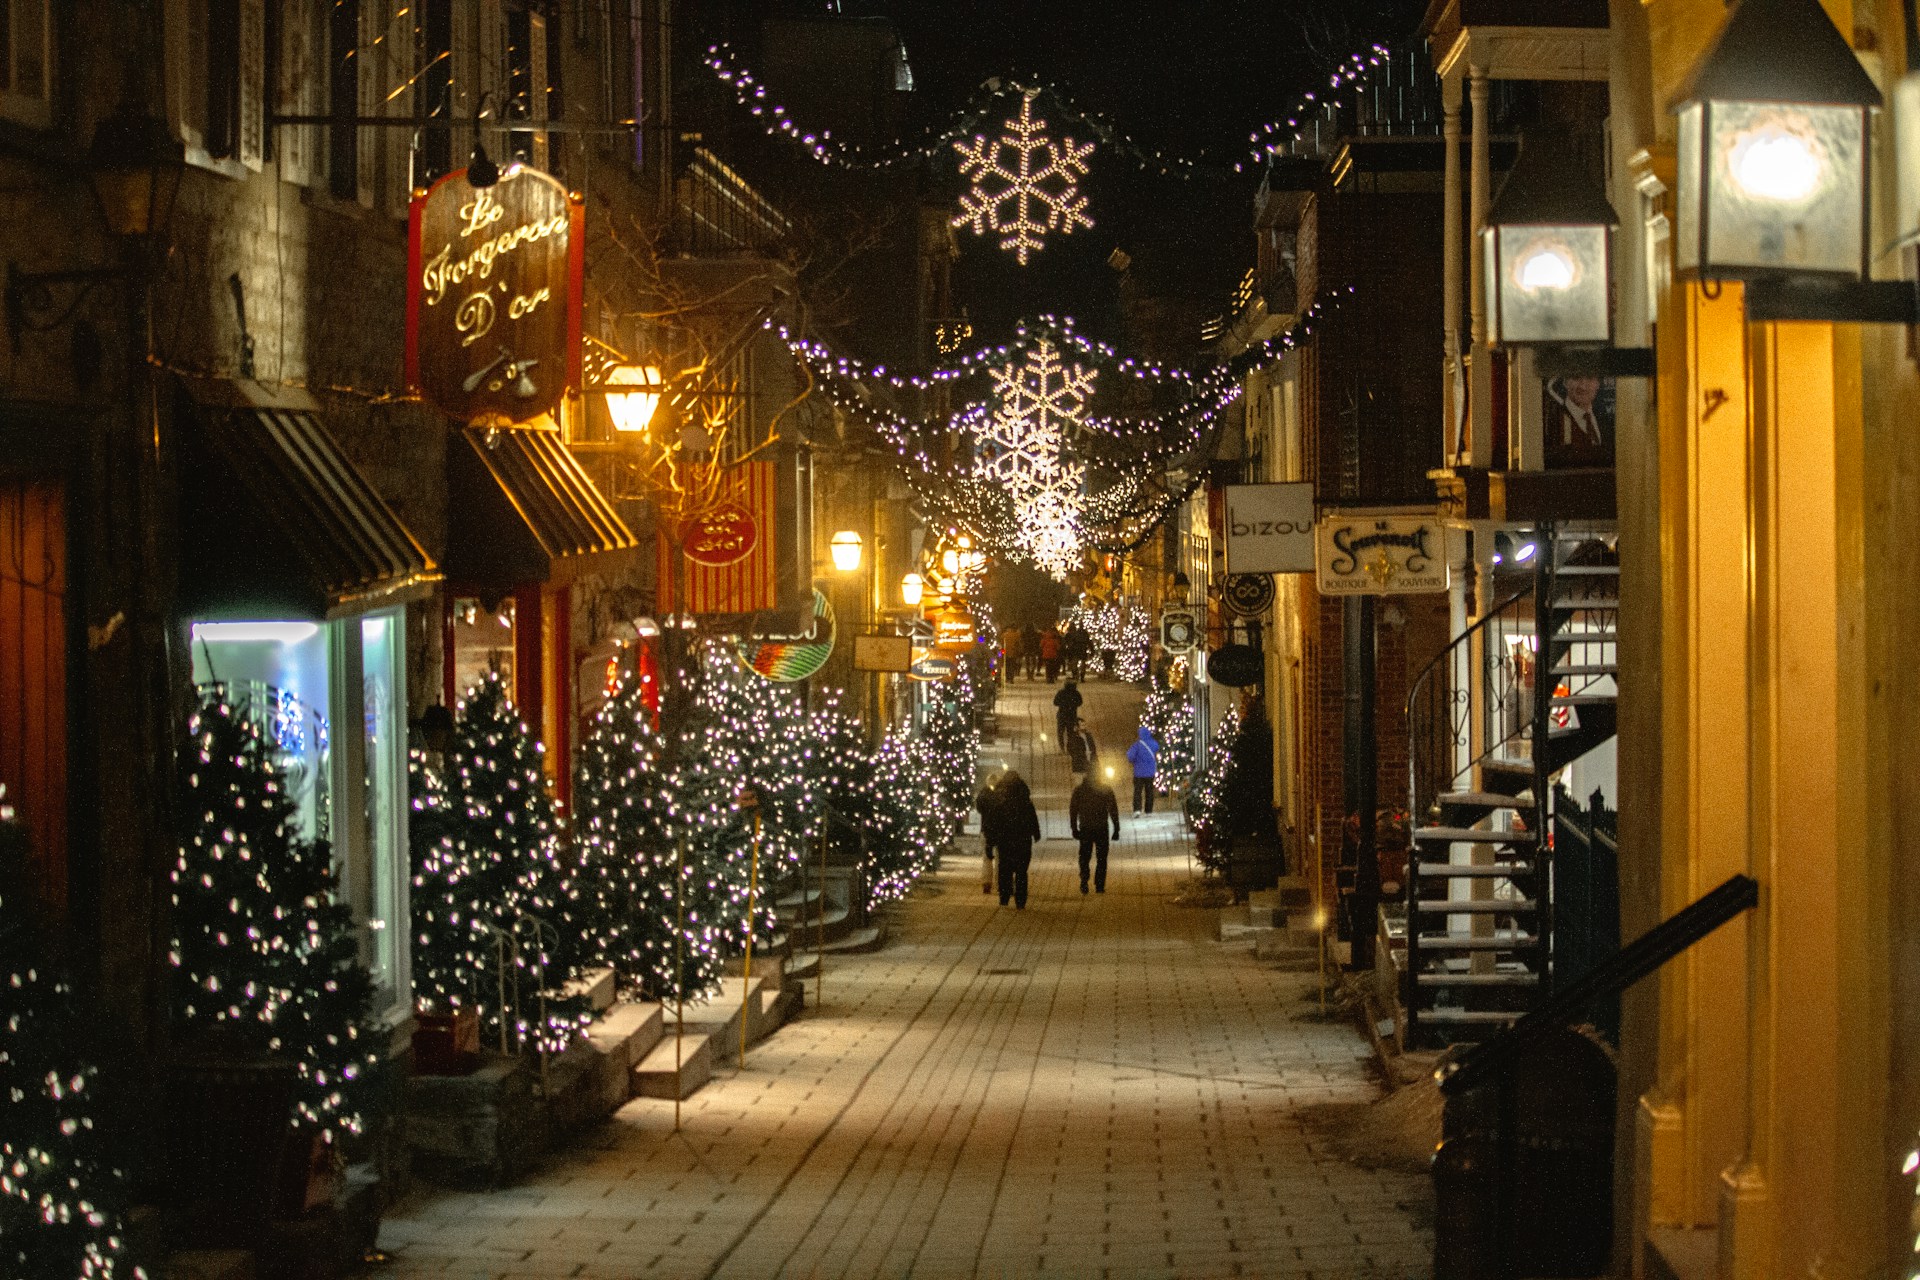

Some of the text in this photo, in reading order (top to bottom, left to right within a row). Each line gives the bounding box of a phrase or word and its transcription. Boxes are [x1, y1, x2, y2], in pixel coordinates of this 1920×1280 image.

[459, 195, 504, 237] Le
[423, 213, 569, 306] Forgeron
[1230, 507, 1313, 538] bizou
